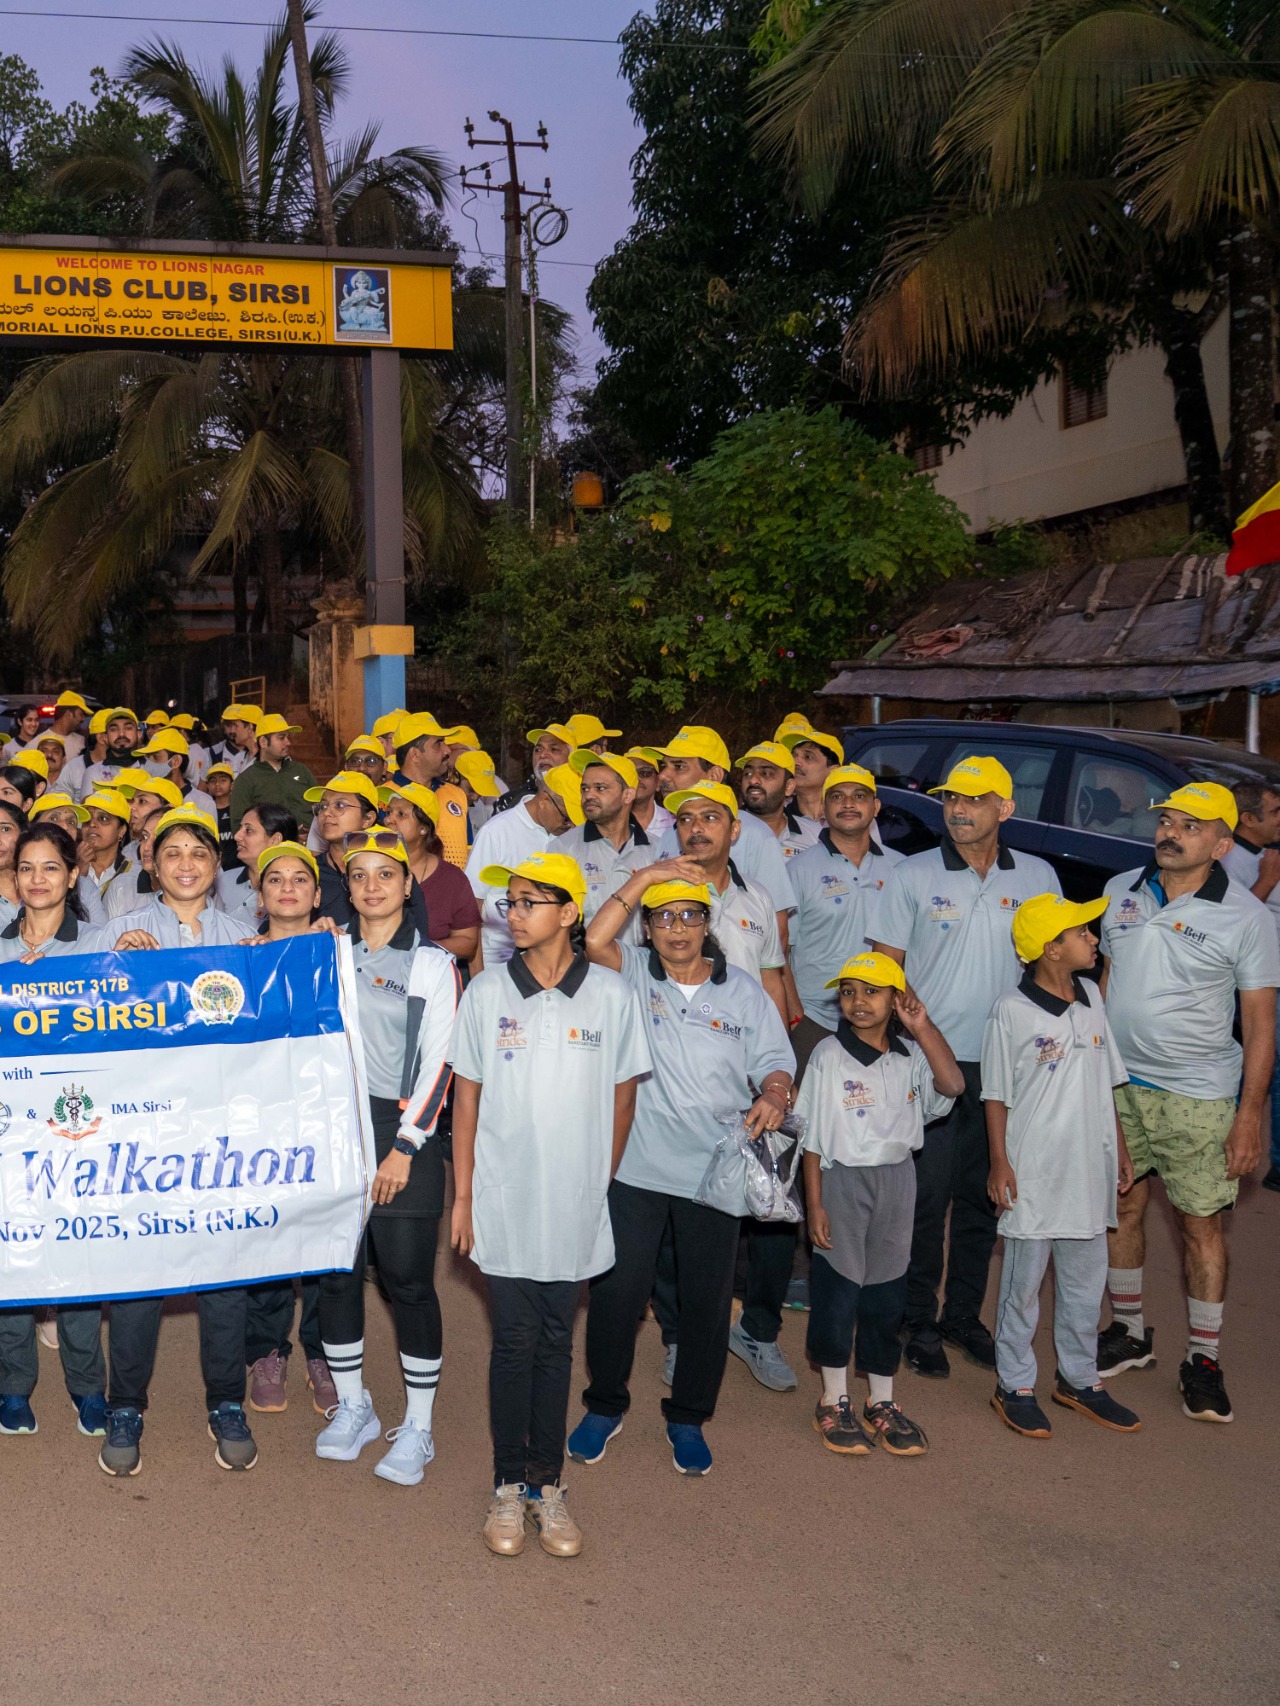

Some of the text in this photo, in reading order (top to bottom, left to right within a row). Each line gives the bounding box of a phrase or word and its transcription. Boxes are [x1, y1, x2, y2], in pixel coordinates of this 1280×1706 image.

[56, 256, 266, 276] WELCOME TO LIONS NAGAR
[13, 273, 310, 306] LIONS CLUB, SIRSI
[64, 323, 116, 335] LIONS
[1114, 912, 1138, 922] Strides
[1183, 925, 1207, 944] Bell
[11, 979, 86, 998] DISTRICT
[89, 977, 130, 994] 317B
[12, 1008, 60, 1036] OF
[71, 1001, 167, 1033] SIRSI
[581, 1029, 602, 1043] Bell
[723, 1021, 742, 1037] Bell
[496, 1036, 528, 1047] Strides
[2, 1066, 34, 1080] with
[111, 1099, 173, 1115] IMA Sirsi
[842, 1094, 876, 1106] Strides
[26, 1108, 38, 1120] &
[20, 1135, 317, 1201] Walkathon
[54, 1214, 129, 1242] 2025,
[137, 1208, 199, 1237] Sirsi
[205, 1204, 280, 1236] (N.K.)
